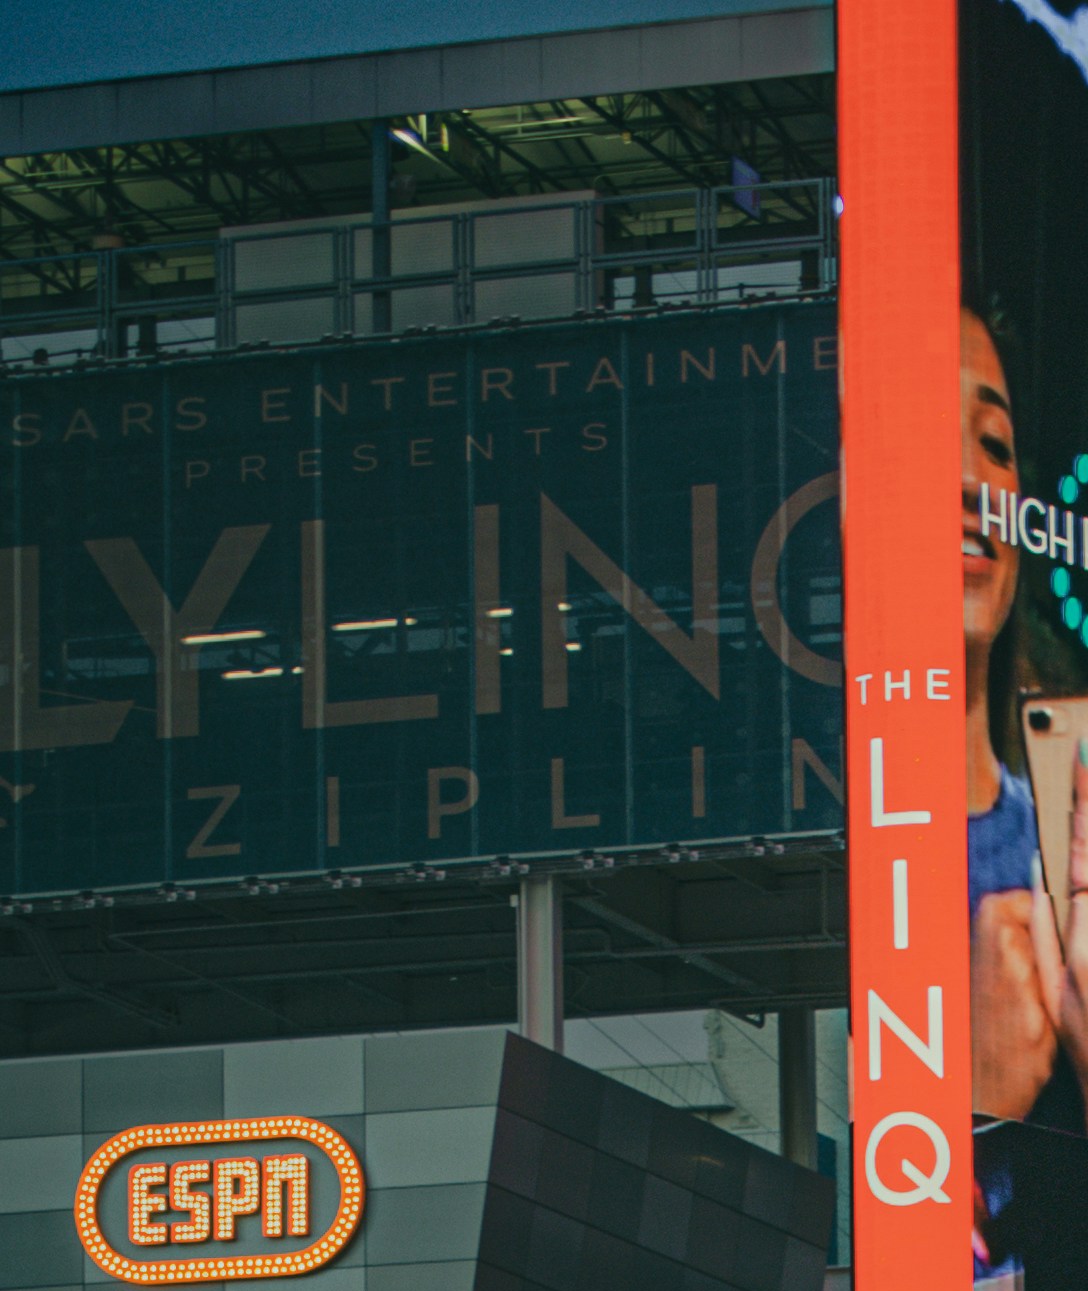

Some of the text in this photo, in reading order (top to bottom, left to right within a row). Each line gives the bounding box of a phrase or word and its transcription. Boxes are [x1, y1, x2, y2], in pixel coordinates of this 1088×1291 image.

[12, 396, 210, 447] SARS
[184, 422, 609, 489] PRESENTS
[980, 482, 1075, 565] HIGH
[855, 668, 951, 705] THE
[865, 737, 951, 1207] LINQ
[128, 1153, 310, 1246] ESPN
